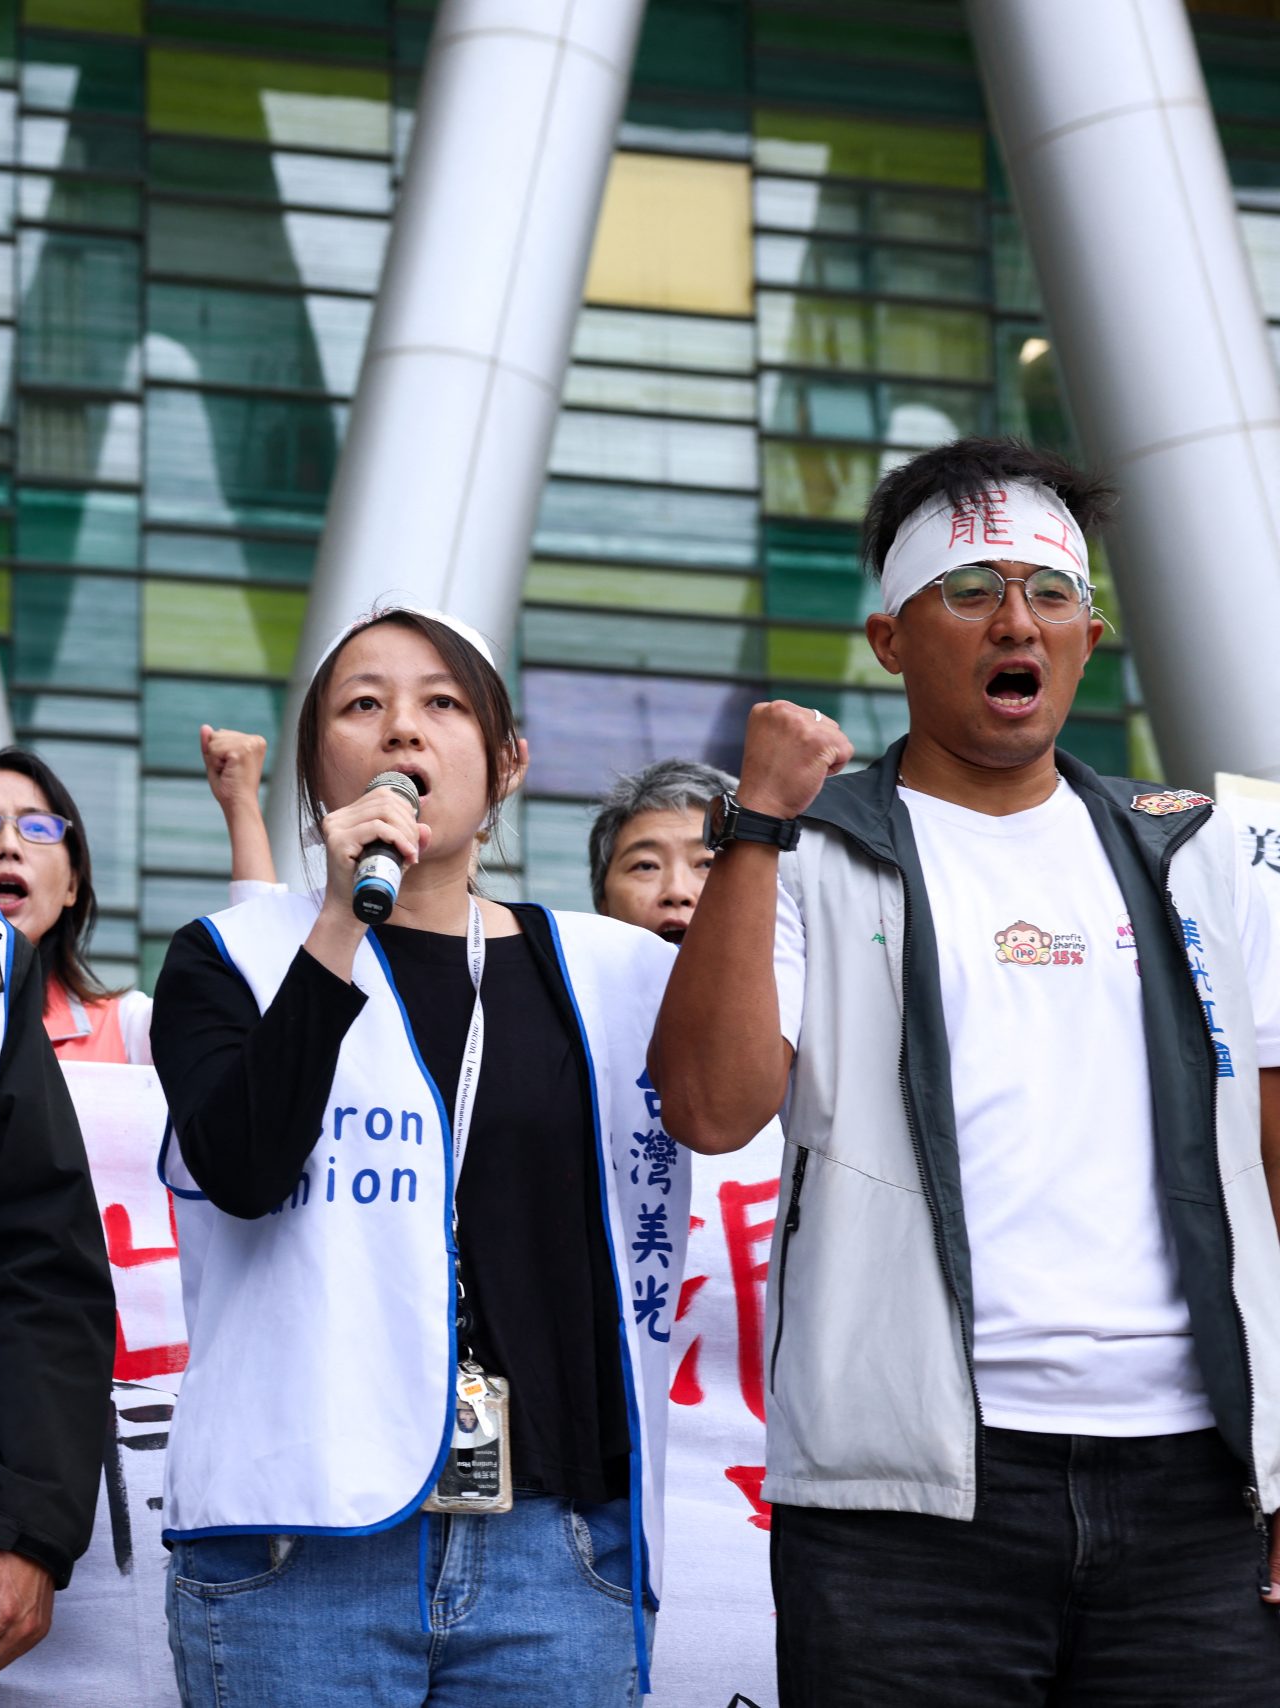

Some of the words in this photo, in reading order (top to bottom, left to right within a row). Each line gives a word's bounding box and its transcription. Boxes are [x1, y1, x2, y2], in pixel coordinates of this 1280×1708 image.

[948, 490, 1082, 570] 罷工
[1053, 942, 1086, 952] sharing
[1054, 934, 1082, 942] profit
[1052, 950, 1084, 965] 15%
[469, 1022, 481, 1054] micron
[465, 1066, 473, 1082] MAS
[458, 1083, 470, 1128] Performance
[321, 1107, 423, 1145] ron
[269, 1156, 418, 1215] nion
